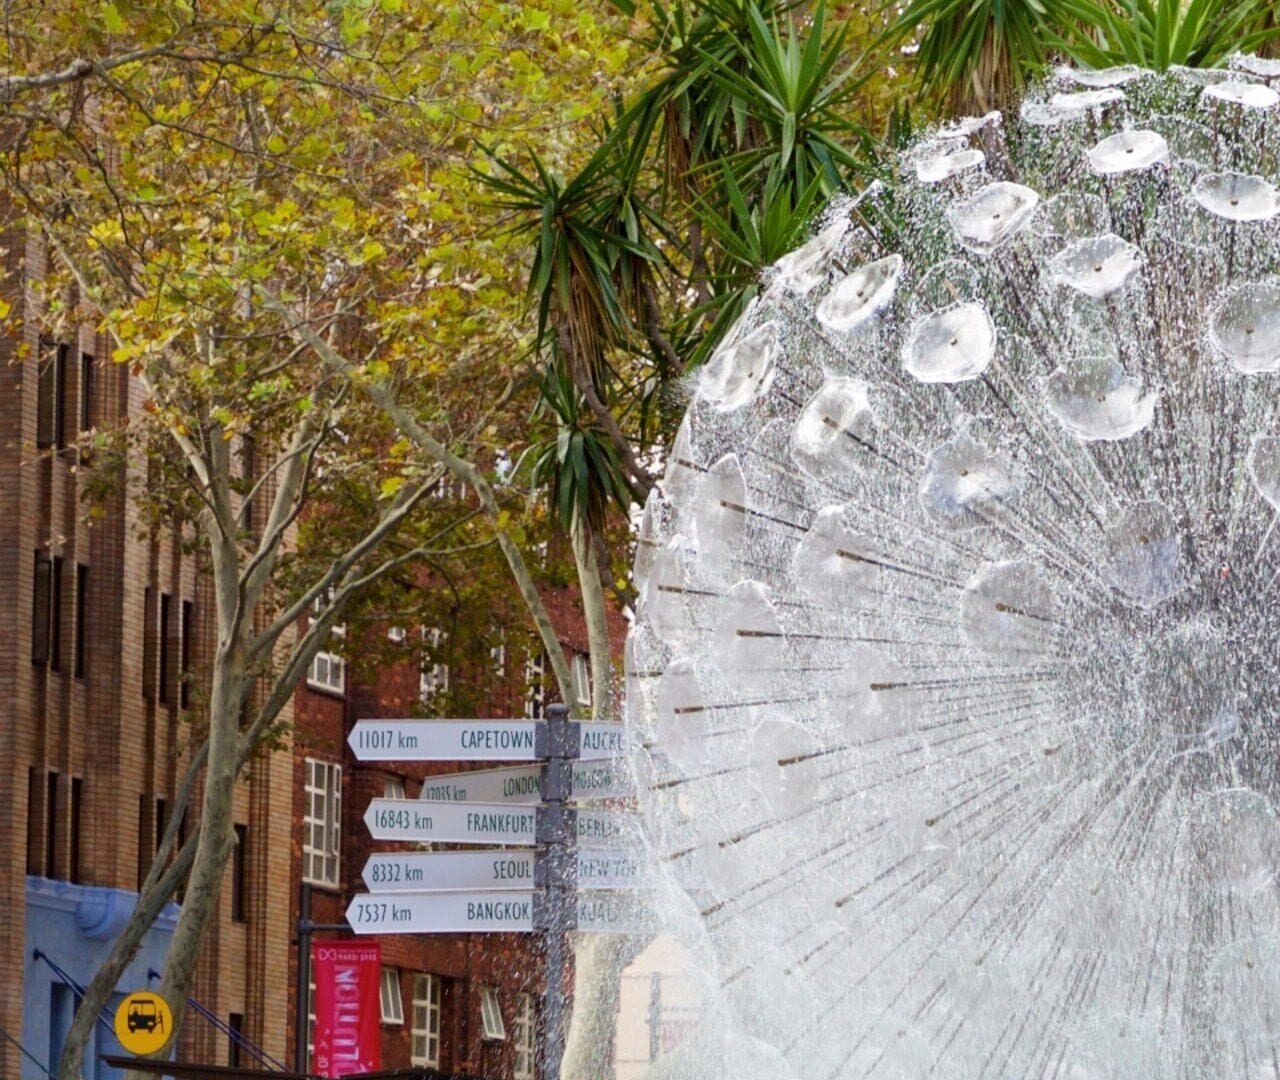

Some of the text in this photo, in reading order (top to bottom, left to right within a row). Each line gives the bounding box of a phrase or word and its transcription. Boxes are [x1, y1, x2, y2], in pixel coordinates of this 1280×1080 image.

[359, 731, 418, 749] 11017 km
[461, 730, 533, 749] CAPETOWN
[453, 784, 467, 800] km
[503, 776, 541, 797] LONDON
[375, 810, 433, 830] 16843 km
[467, 813, 534, 833] FRANKFURT
[372, 863, 424, 882] 8332 km
[493, 861, 532, 880] SEOUL
[357, 904, 412, 923] 7537 km
[467, 902, 531, 920] BANGKOK
[332, 965, 360, 1079] OLUTION
